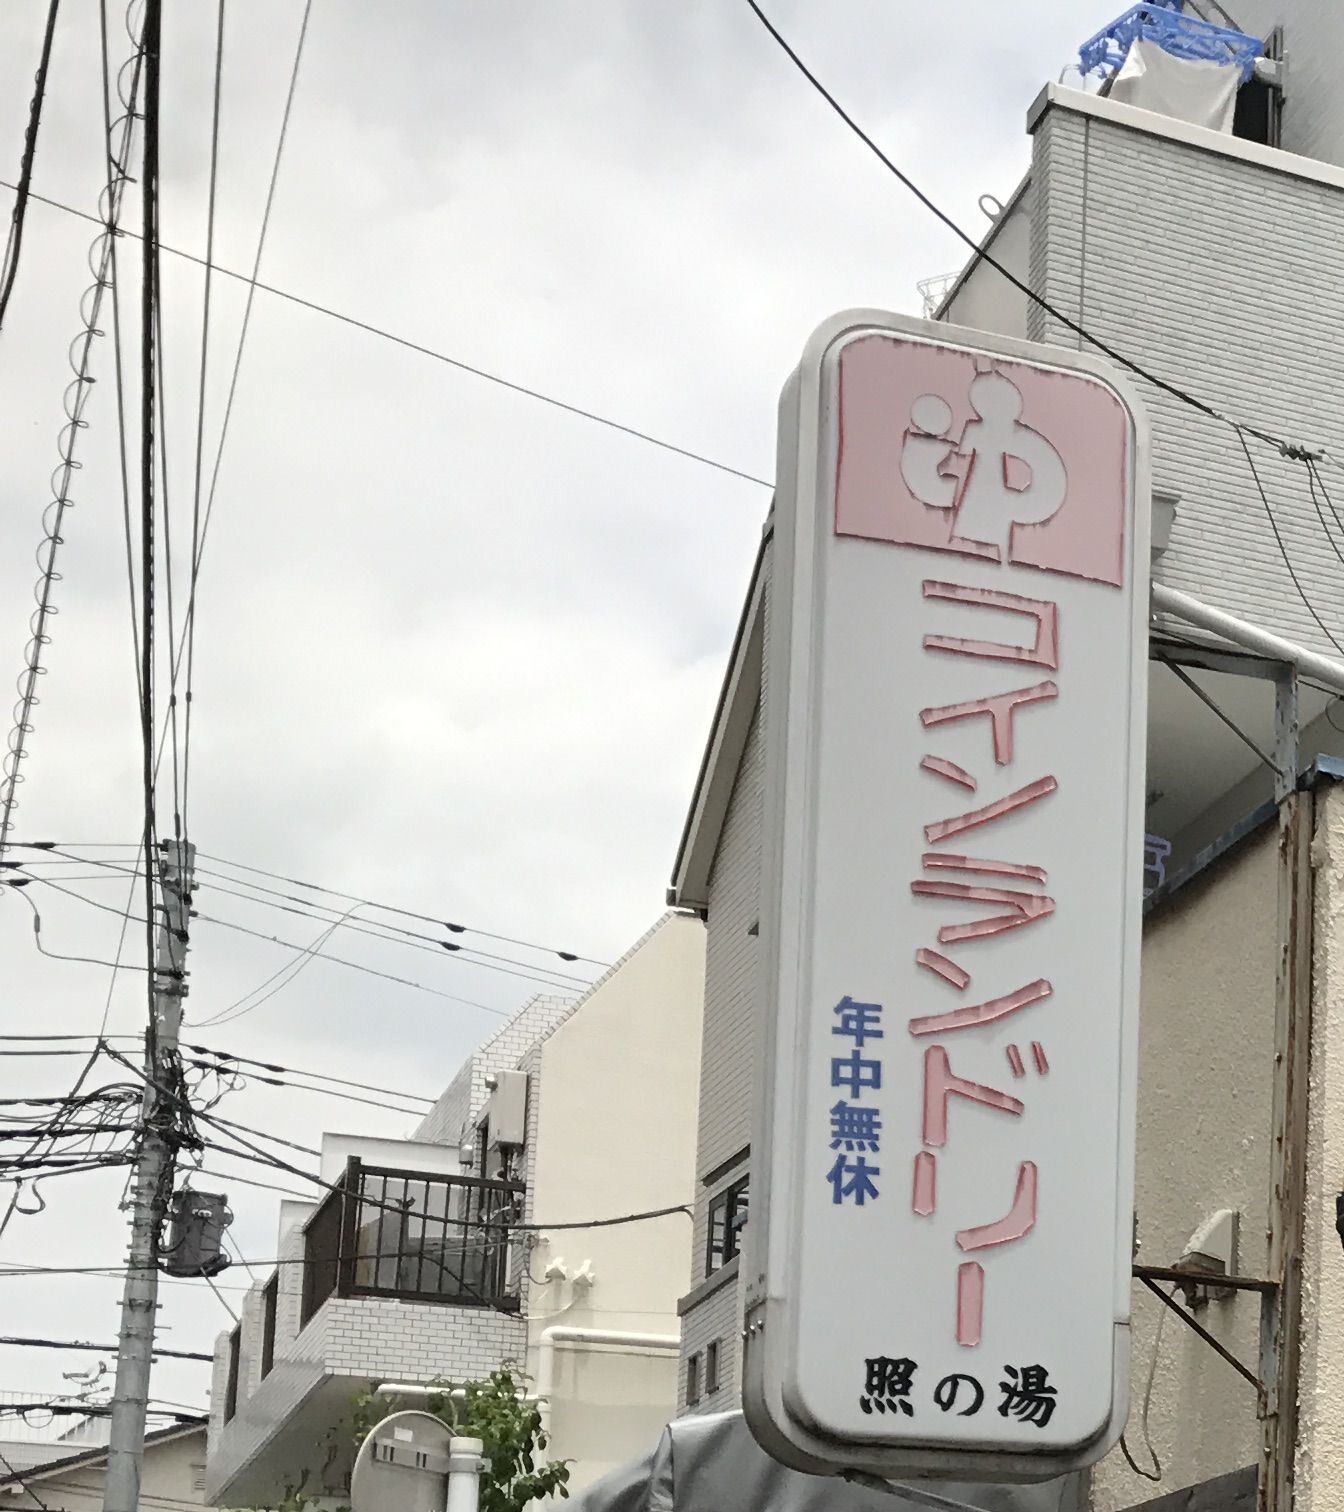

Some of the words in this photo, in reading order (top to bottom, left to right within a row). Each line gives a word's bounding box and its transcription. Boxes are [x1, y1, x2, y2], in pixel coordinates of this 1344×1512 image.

[909, 578, 1060, 1349] コインランドリー
[826, 994, 885, 1208] 年中無休
[859, 1355, 1058, 1428] 照の湯
